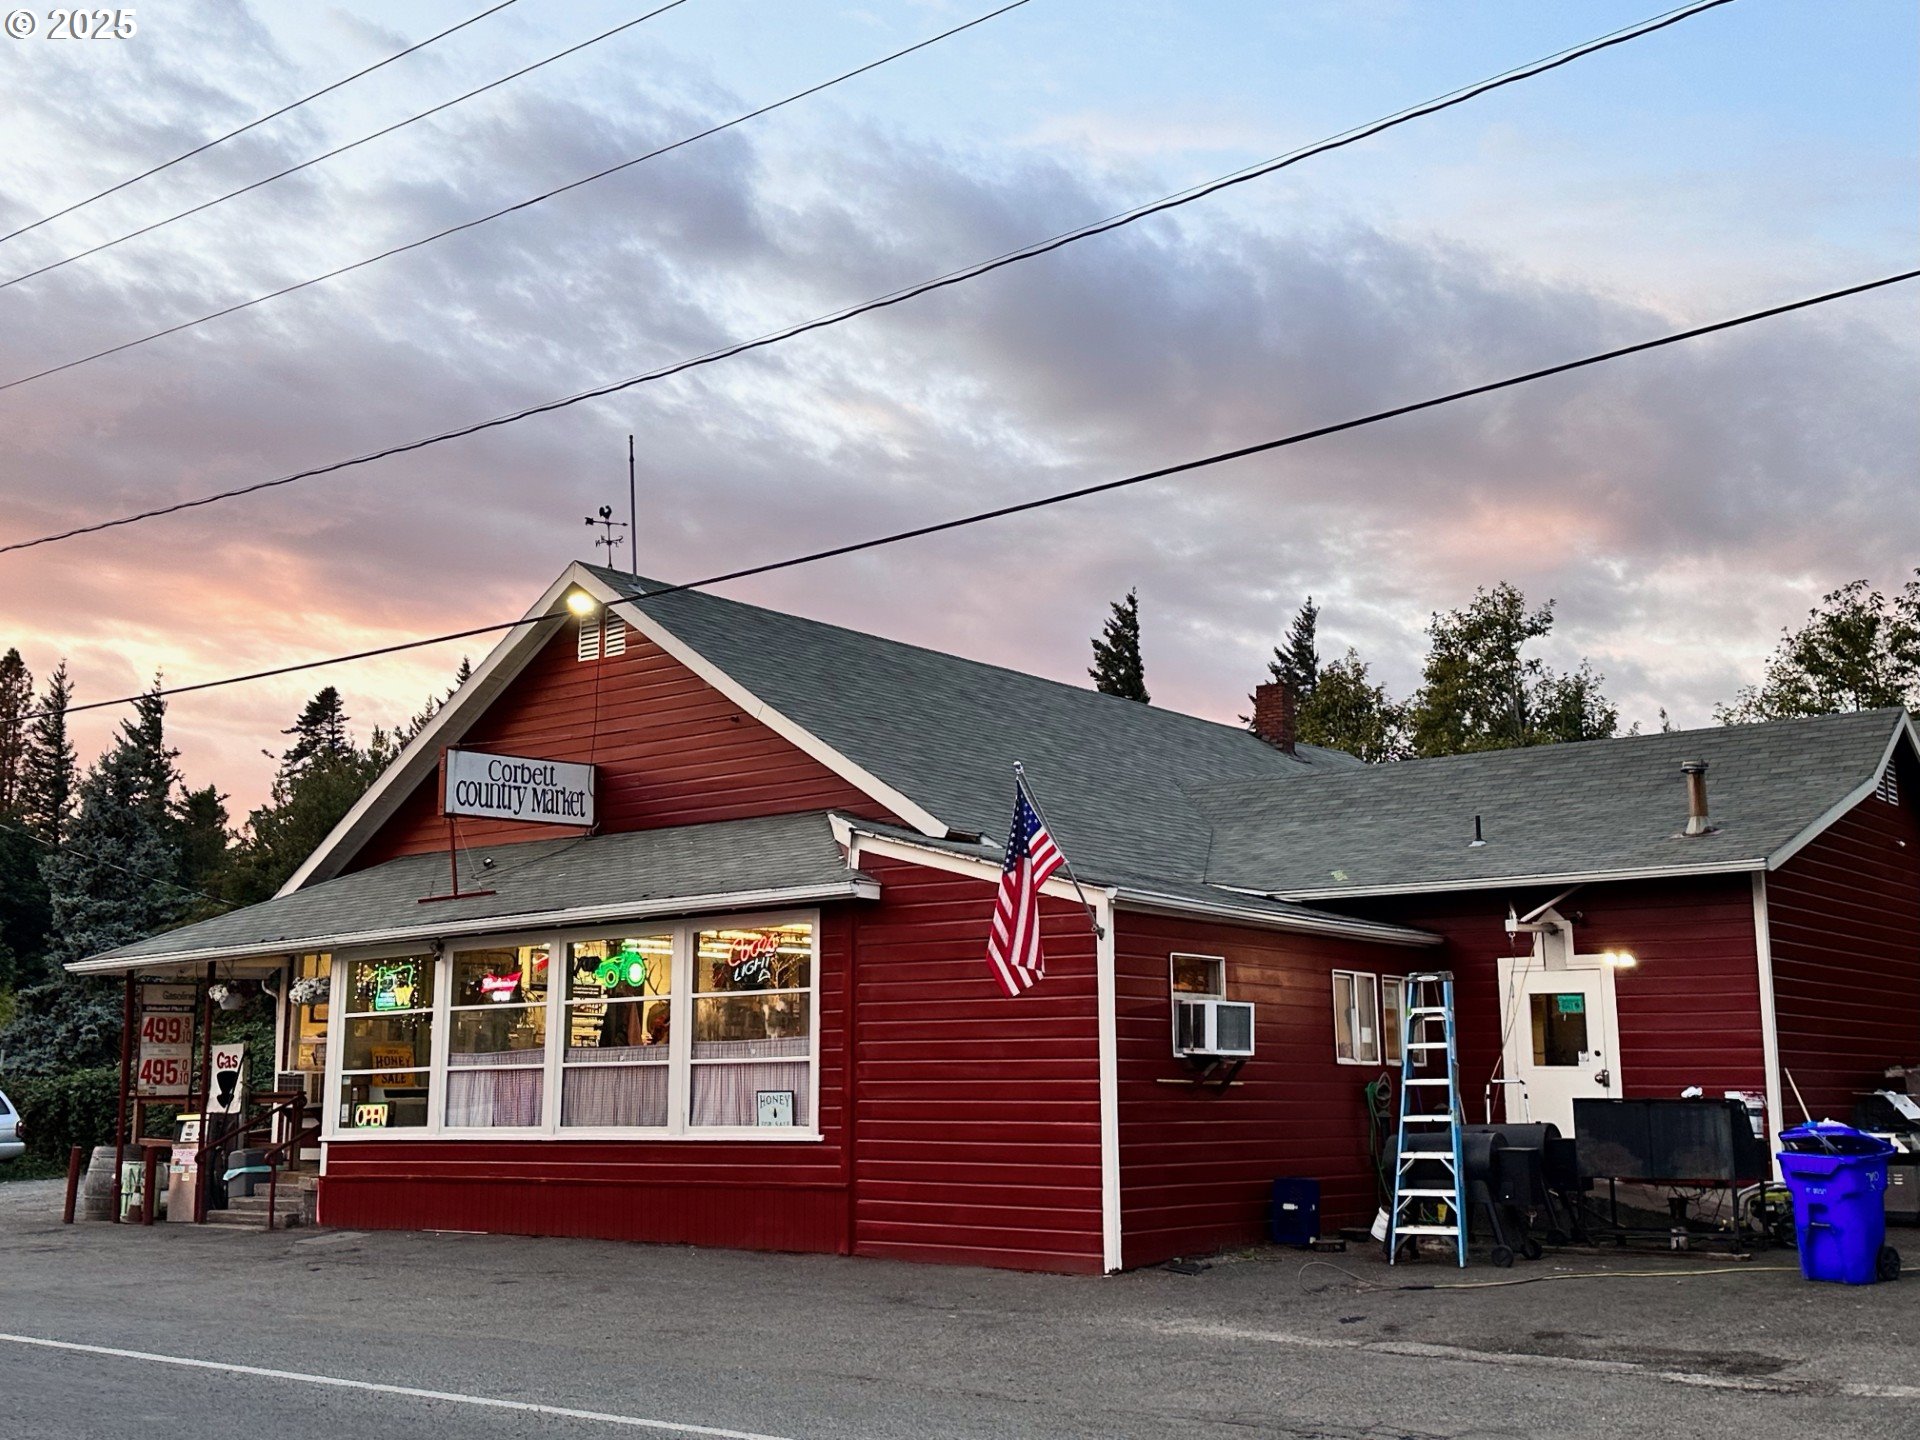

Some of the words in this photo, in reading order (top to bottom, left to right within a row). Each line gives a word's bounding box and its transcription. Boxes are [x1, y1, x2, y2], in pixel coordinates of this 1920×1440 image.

[488, 759, 558, 787] Corbett
[531, 787, 586, 818] Market
[733, 953, 773, 982] LIGHT
[143, 1017, 181, 1043] 499
[140, 1059, 179, 1085] 495
[216, 1051, 239, 1069] Gas
[375, 1055, 411, 1069] HONEY
[381, 1073, 407, 1085] SALE
[759, 1094, 791, 1109] HONEY
[354, 1105, 388, 1127] OPEN
